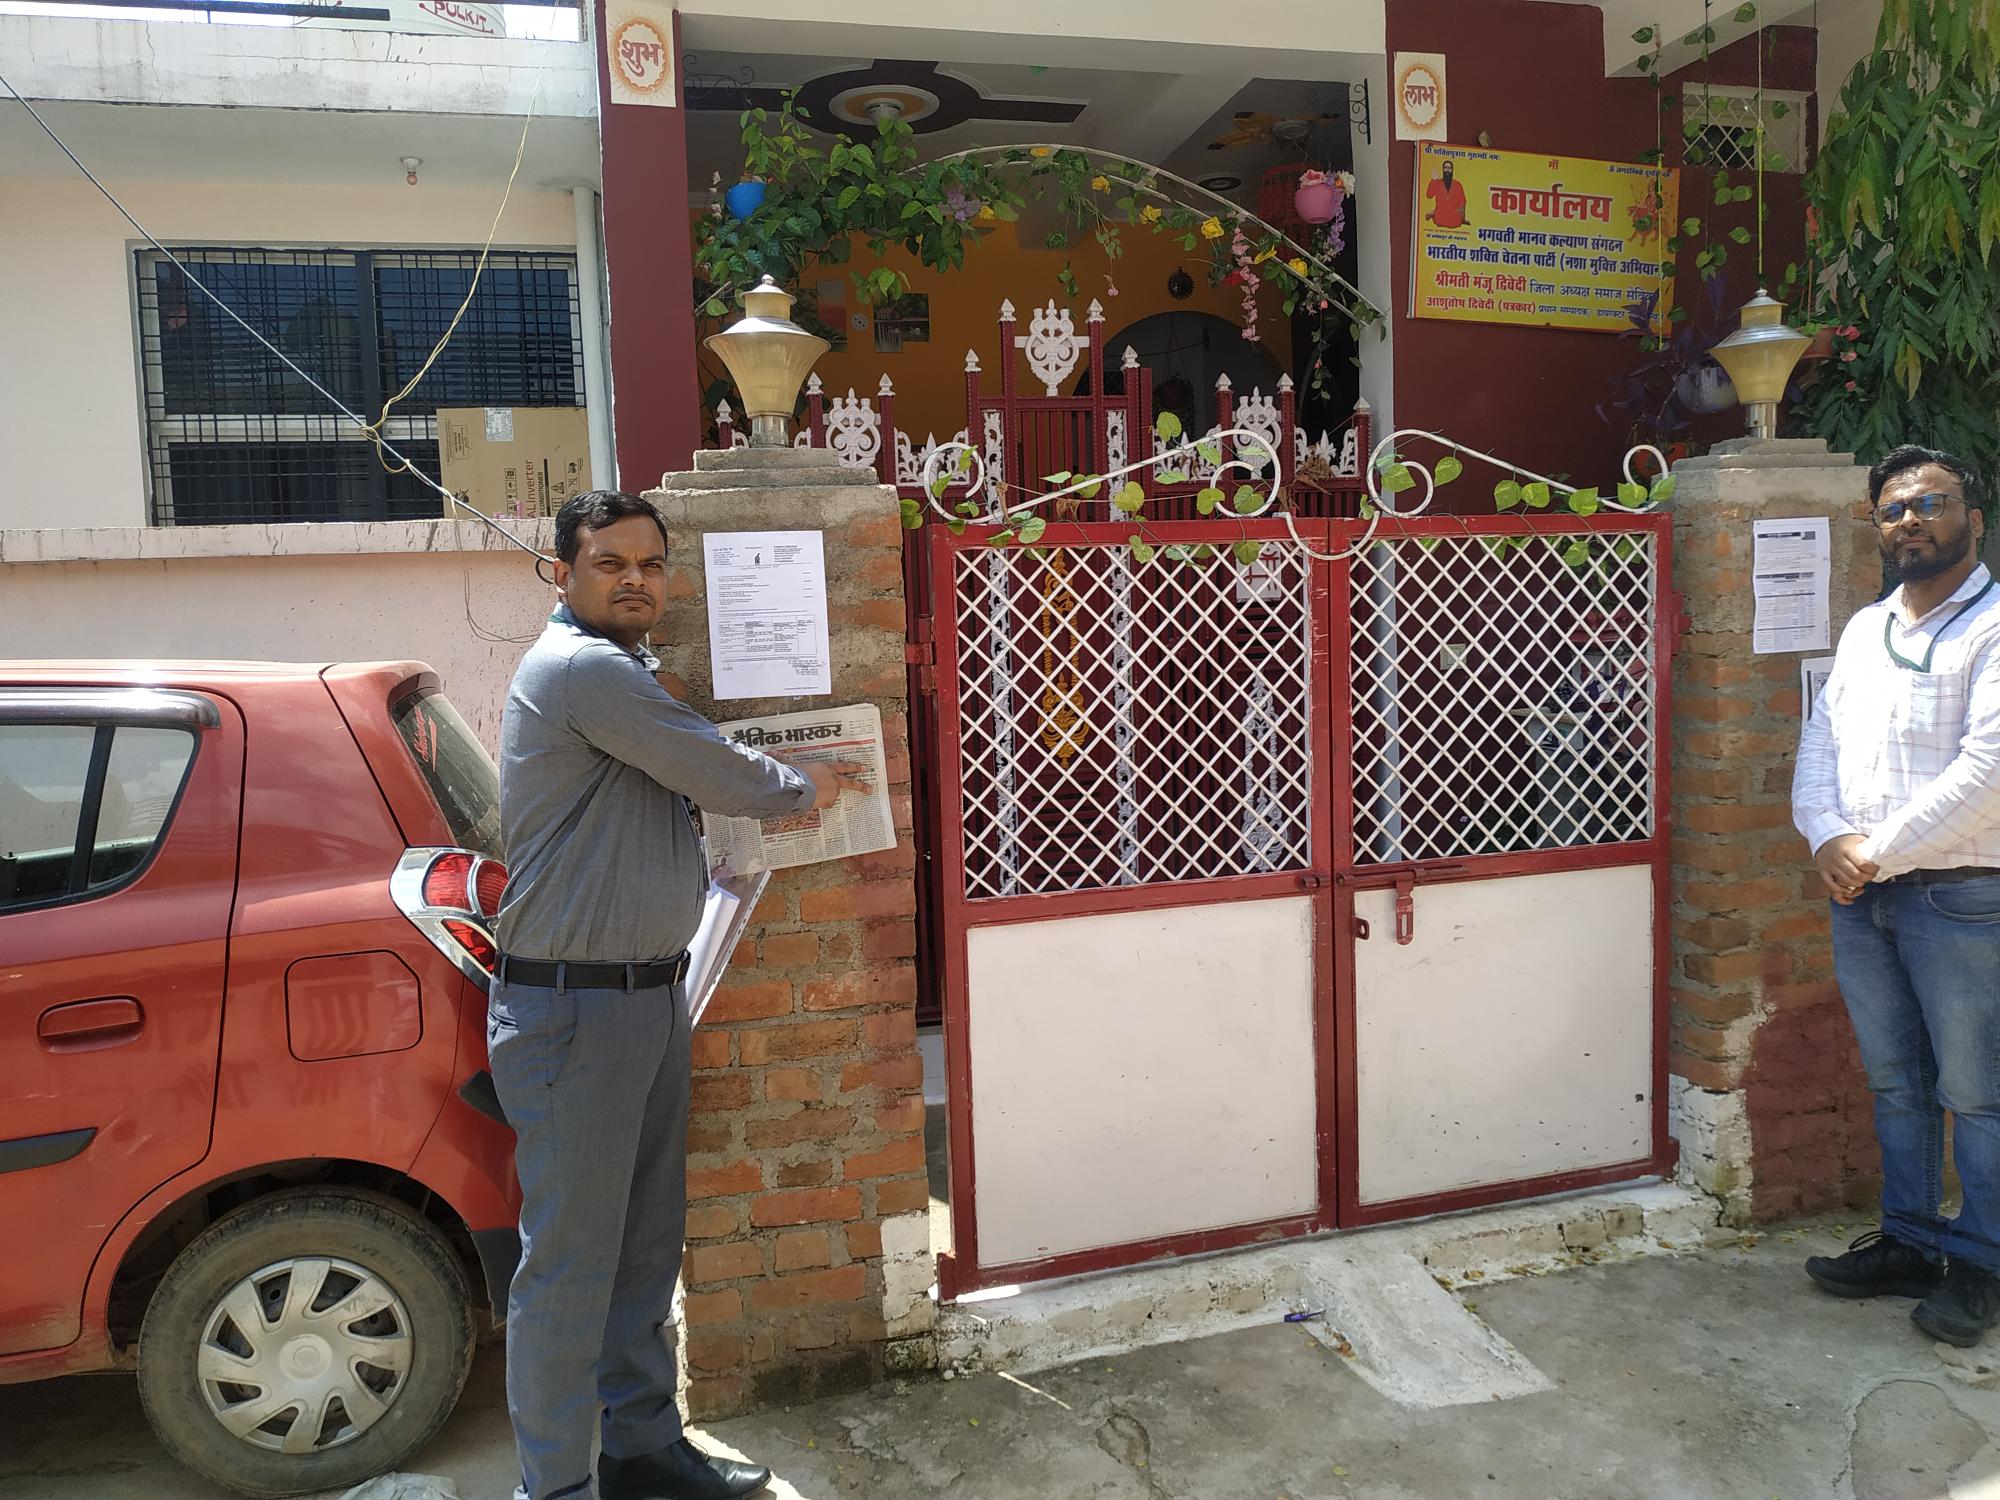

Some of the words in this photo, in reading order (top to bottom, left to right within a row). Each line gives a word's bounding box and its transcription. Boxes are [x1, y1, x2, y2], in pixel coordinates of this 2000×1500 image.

[434, 0, 487, 31] PULKIT
[621, 39, 661, 77] शुभ
[1404, 85, 1436, 108] लाभ
[1489, 183, 1613, 223] कार्यालय
[1478, 227, 1515, 244] भगवती
[1518, 231, 1547, 246] मानव
[1549, 234, 1588, 249] कल्याण
[1427, 244, 1467, 261] भारतीय
[1469, 246, 1499, 263] शक्ति
[1502, 248, 1531, 266] चेतना
[1533, 252, 1557, 268] पार्टी
[1560, 252, 1587, 272] (नशा
[1589, 256, 1617, 275] मुक्ति
[1435, 270, 1470, 289] श्रीमती
[1473, 272, 1494, 295] मंजू
[1496, 274, 1527, 292] द्विवेदी
[1530, 278, 1555, 294] जिला
[1560, 285, 1591, 298] अध्यक्ष
[1594, 288, 1622, 300] समाज
[1426, 296, 1465, 310] आशुतोष
[1468, 297, 1495, 310] द्विवेदी
[1498, 299, 1536, 315] (पत्रकार)
[524, 459, 536, 503] Inverter
[537, 471, 546, 511] CONDITIONER
[731, 726, 782, 748] दैनिक
[784, 723, 843, 742] भास्कर
